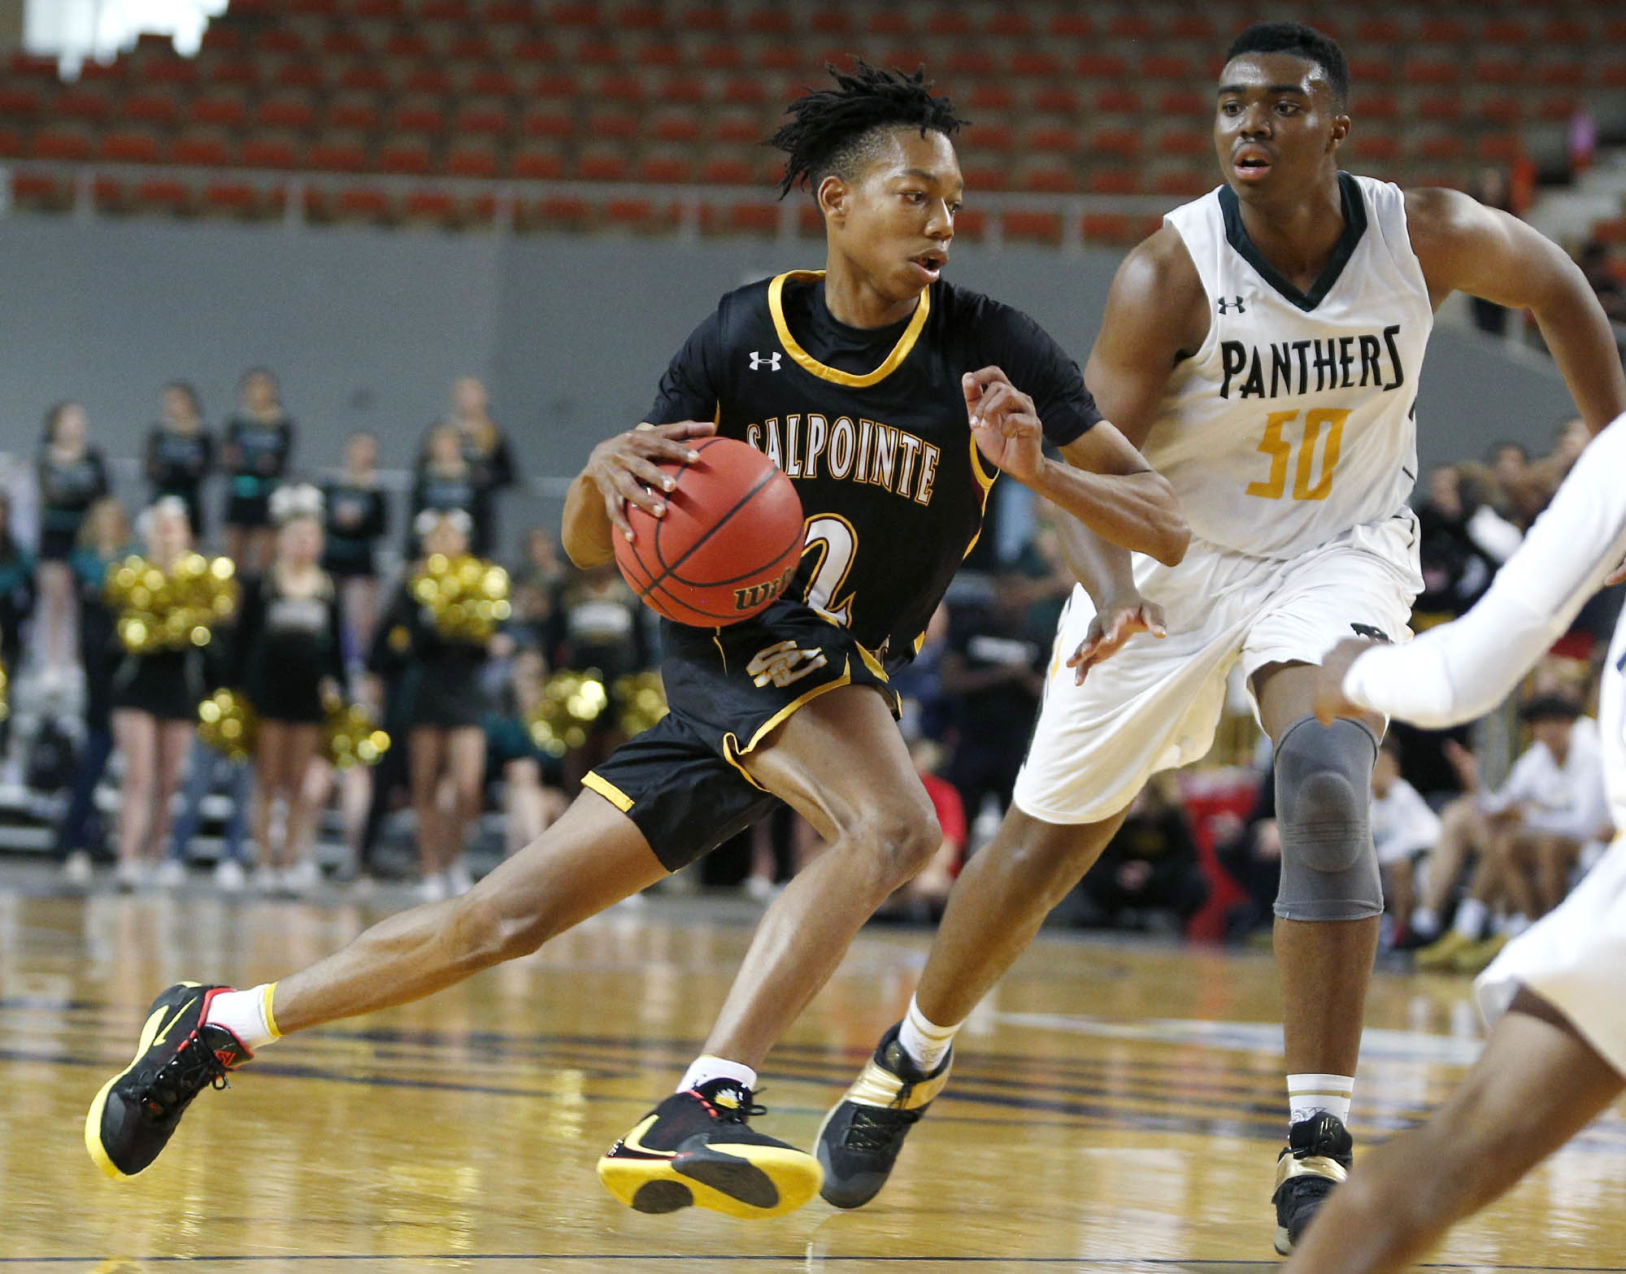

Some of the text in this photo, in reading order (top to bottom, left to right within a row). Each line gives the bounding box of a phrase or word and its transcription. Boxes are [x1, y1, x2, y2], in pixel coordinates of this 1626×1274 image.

[1220, 324, 1404, 400] PANTHERS
[1245, 407, 1354, 501] 50
[801, 512, 859, 629] 2
